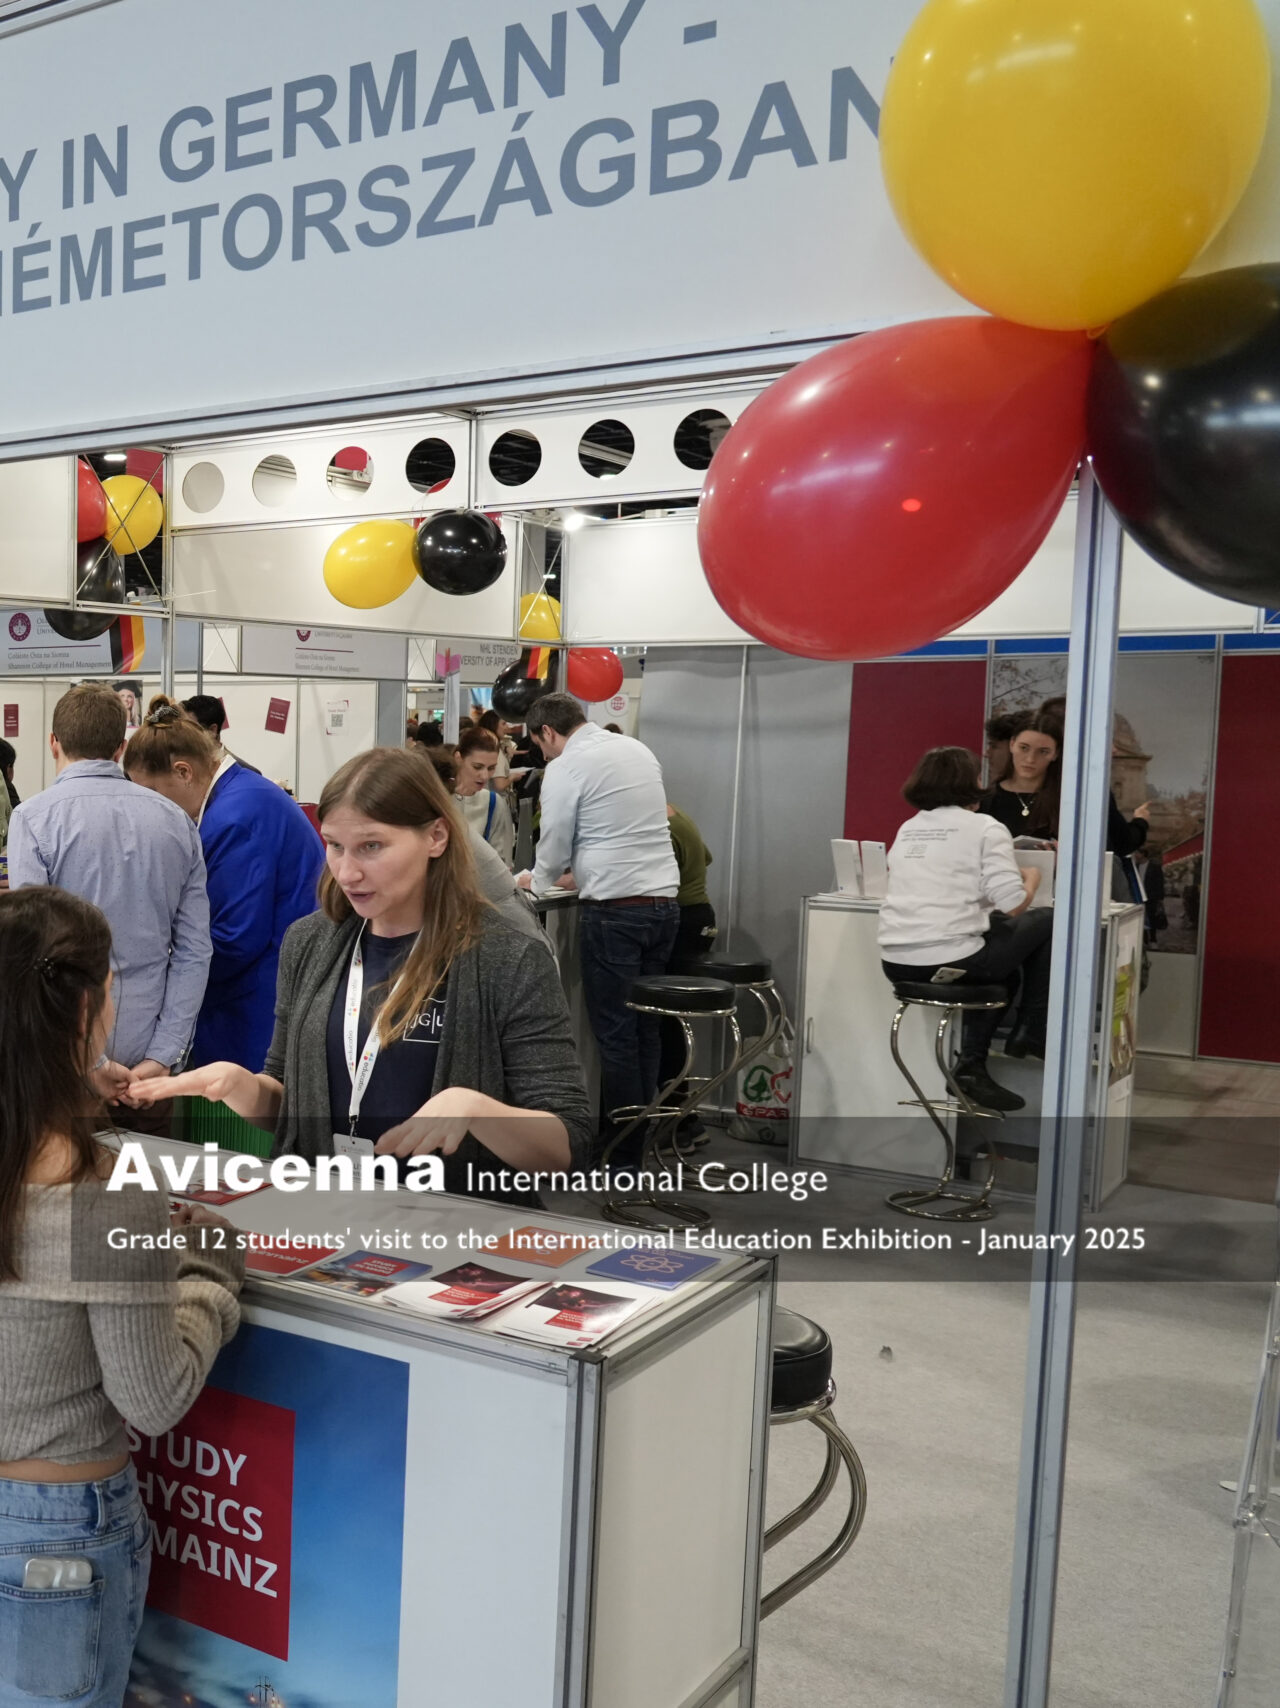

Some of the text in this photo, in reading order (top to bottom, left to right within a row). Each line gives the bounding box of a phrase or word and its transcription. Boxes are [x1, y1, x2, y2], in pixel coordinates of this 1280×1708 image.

[62, 124, 129, 210] IN
[159, 0, 646, 183] GERMANY
[138, 1471, 263, 1542] HYSICS
[150, 1520, 278, 1598] MAINZ
